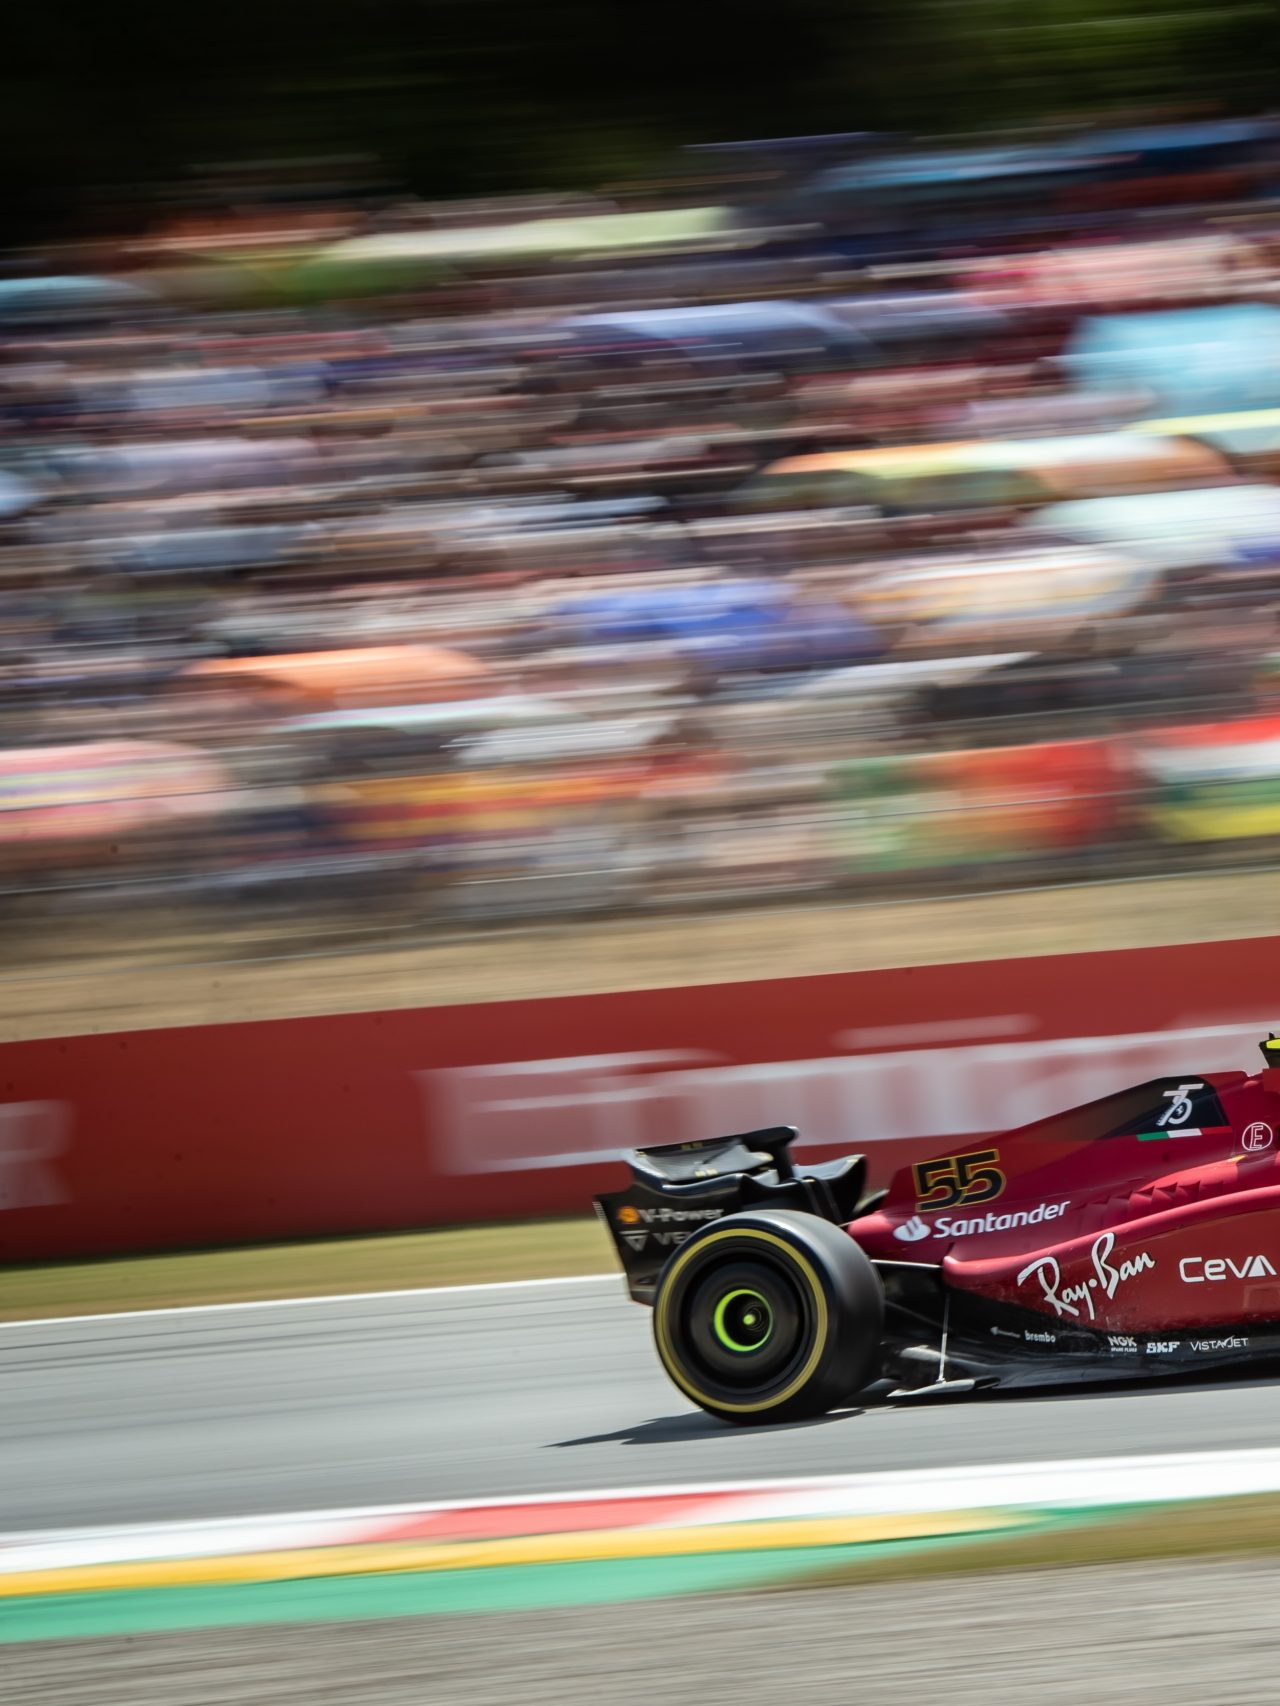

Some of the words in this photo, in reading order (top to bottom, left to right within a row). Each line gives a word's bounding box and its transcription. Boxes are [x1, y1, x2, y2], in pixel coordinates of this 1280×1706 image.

[912, 1148, 1007, 1213] 55
[638, 1207, 724, 1224] V-Power
[932, 1201, 1071, 1239] Santander
[652, 1231, 693, 1246] VE
[1024, 1330, 1056, 1343] brembo
[1107, 1335, 1138, 1347] NGK
[1145, 1341, 1181, 1354] SKF
